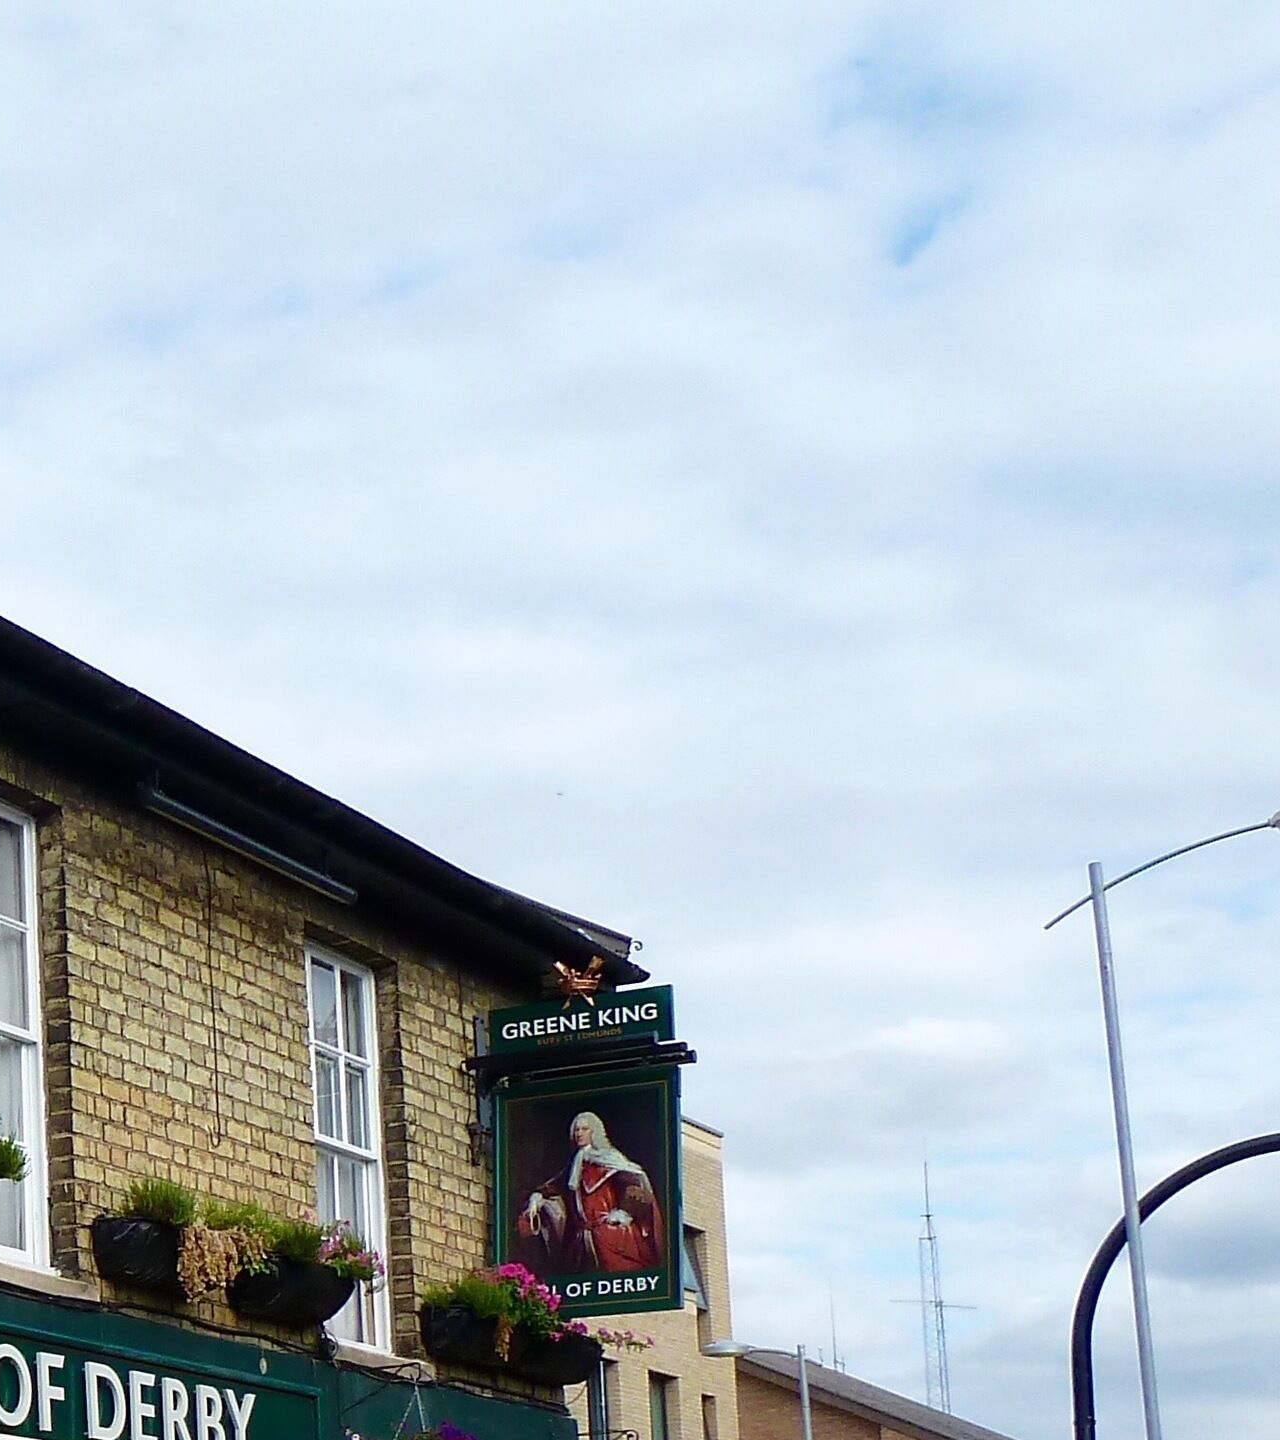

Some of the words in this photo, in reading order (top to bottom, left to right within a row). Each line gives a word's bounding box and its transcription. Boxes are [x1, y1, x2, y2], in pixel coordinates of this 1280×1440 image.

[502, 1012, 591, 1039] GREENE
[598, 1003, 658, 1027] KING
[566, 1282, 592, 1297] OF
[597, 1276, 659, 1295] DERBY
